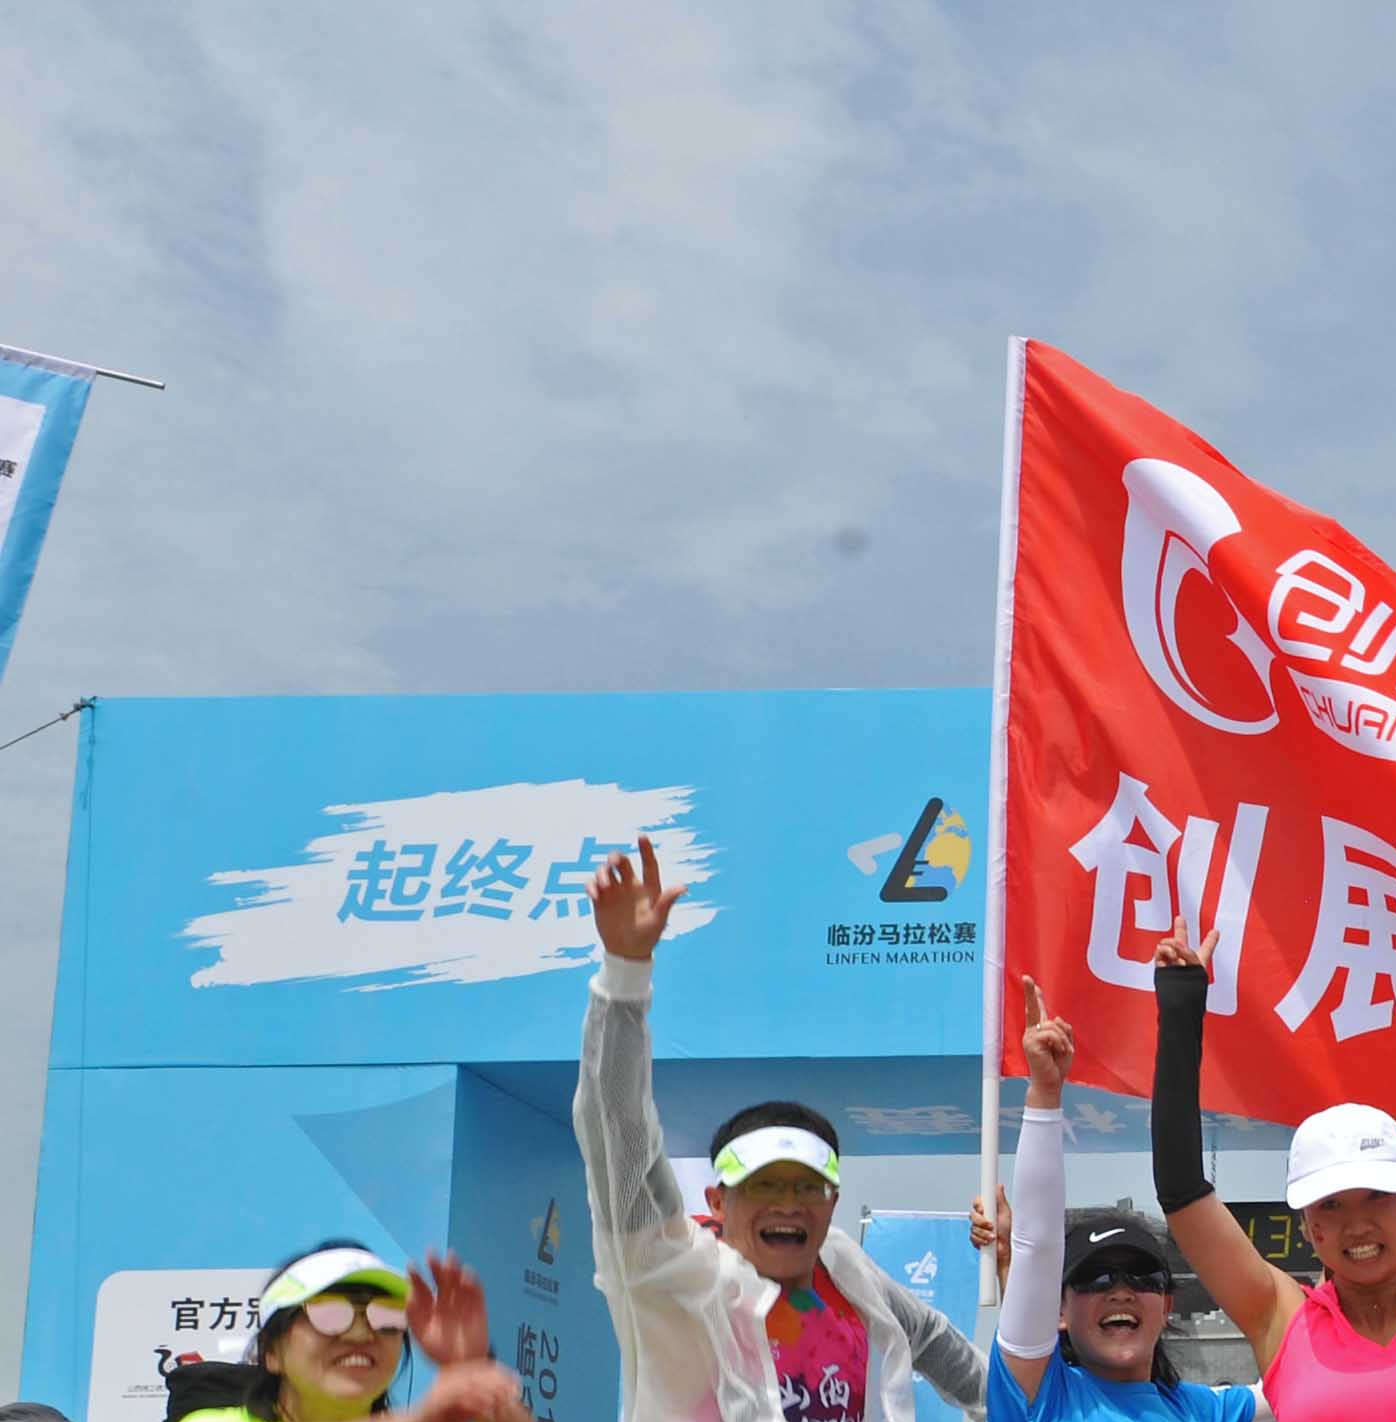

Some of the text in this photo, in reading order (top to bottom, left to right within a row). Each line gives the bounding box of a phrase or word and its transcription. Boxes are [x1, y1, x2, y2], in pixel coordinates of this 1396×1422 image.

[827, 921, 977, 946] 临汾马拉松赛
[826, 950, 975, 965] LINFEN MARATHON
